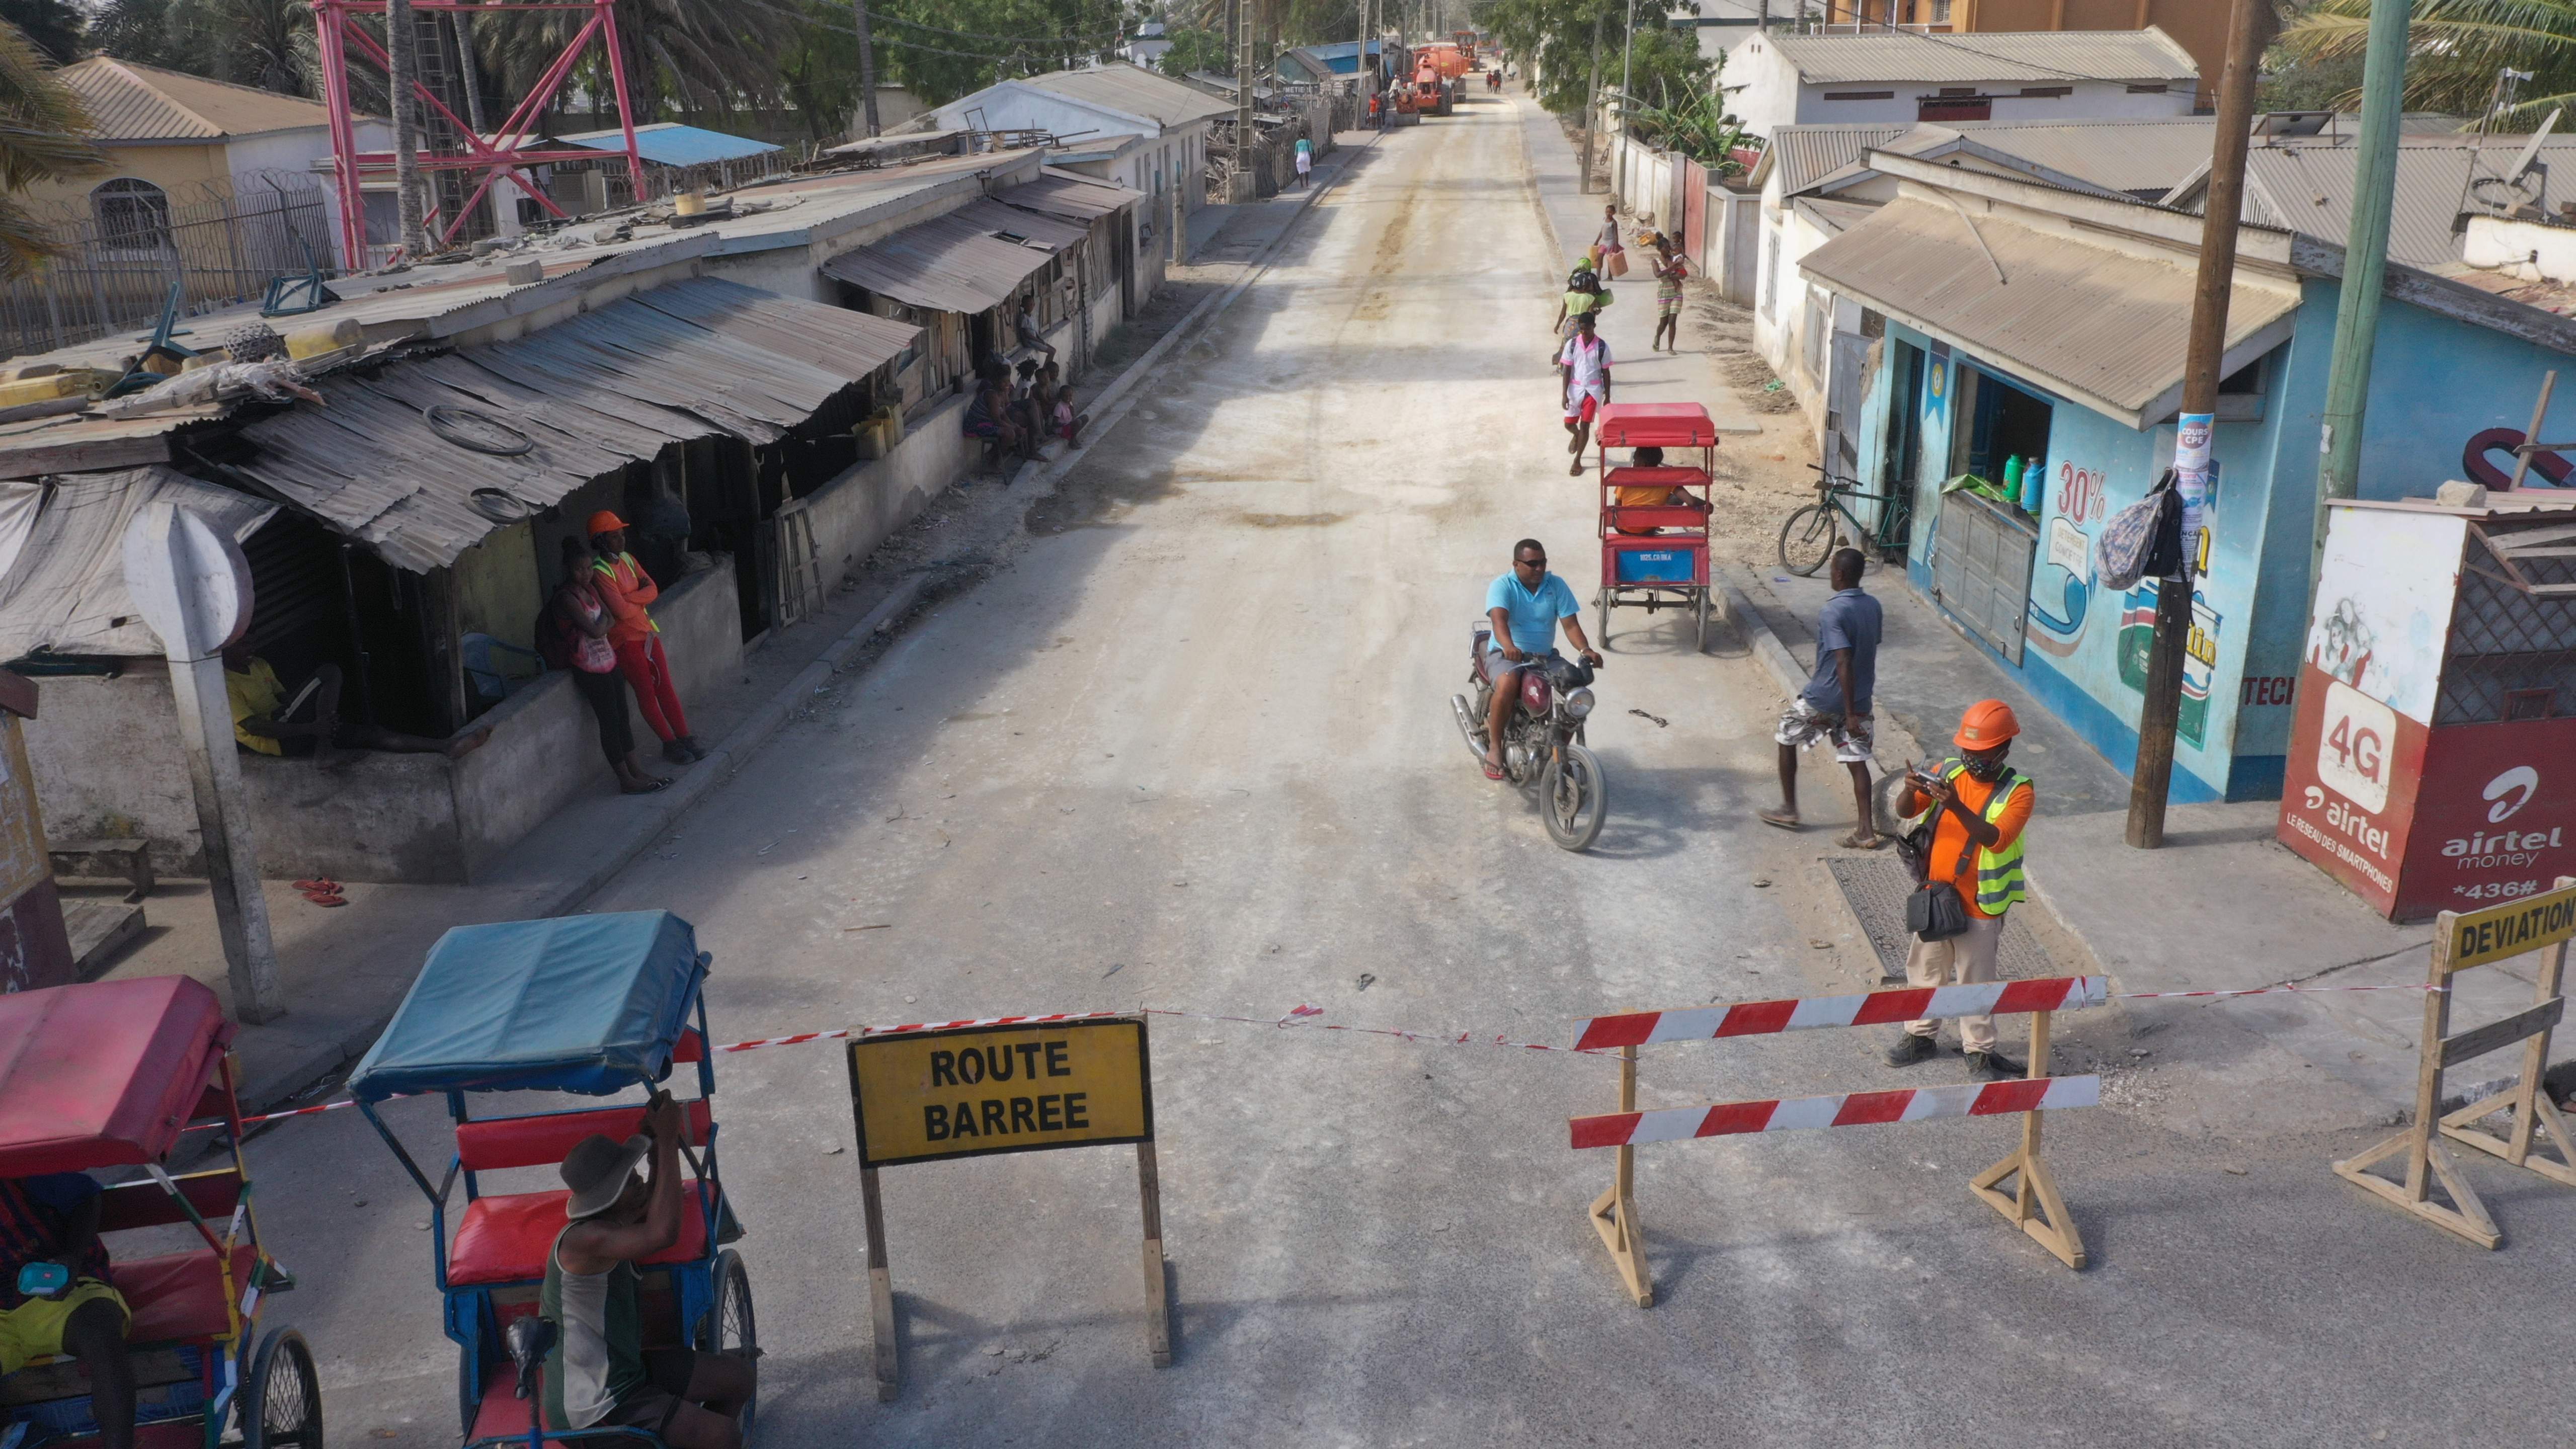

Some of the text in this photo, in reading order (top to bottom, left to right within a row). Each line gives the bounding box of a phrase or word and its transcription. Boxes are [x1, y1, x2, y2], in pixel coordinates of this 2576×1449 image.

[2182, 428, 2208, 436] COURS
[2058, 461, 2105, 525] 30%
[2186, 622, 2216, 668] lin
[2328, 715, 2382, 783] 4G
[2286, 813, 2393, 894] LE RESEAU DES SMARTPHONES
[2326, 802, 2389, 860] airtel
[2442, 827, 2562, 856] airtel
[2457, 852, 2539, 869] money
[2460, 897, 2576, 958] DEVIATION
[930, 1040, 1071, 1087] ROUTE
[924, 1092, 1089, 1142] BARREE
